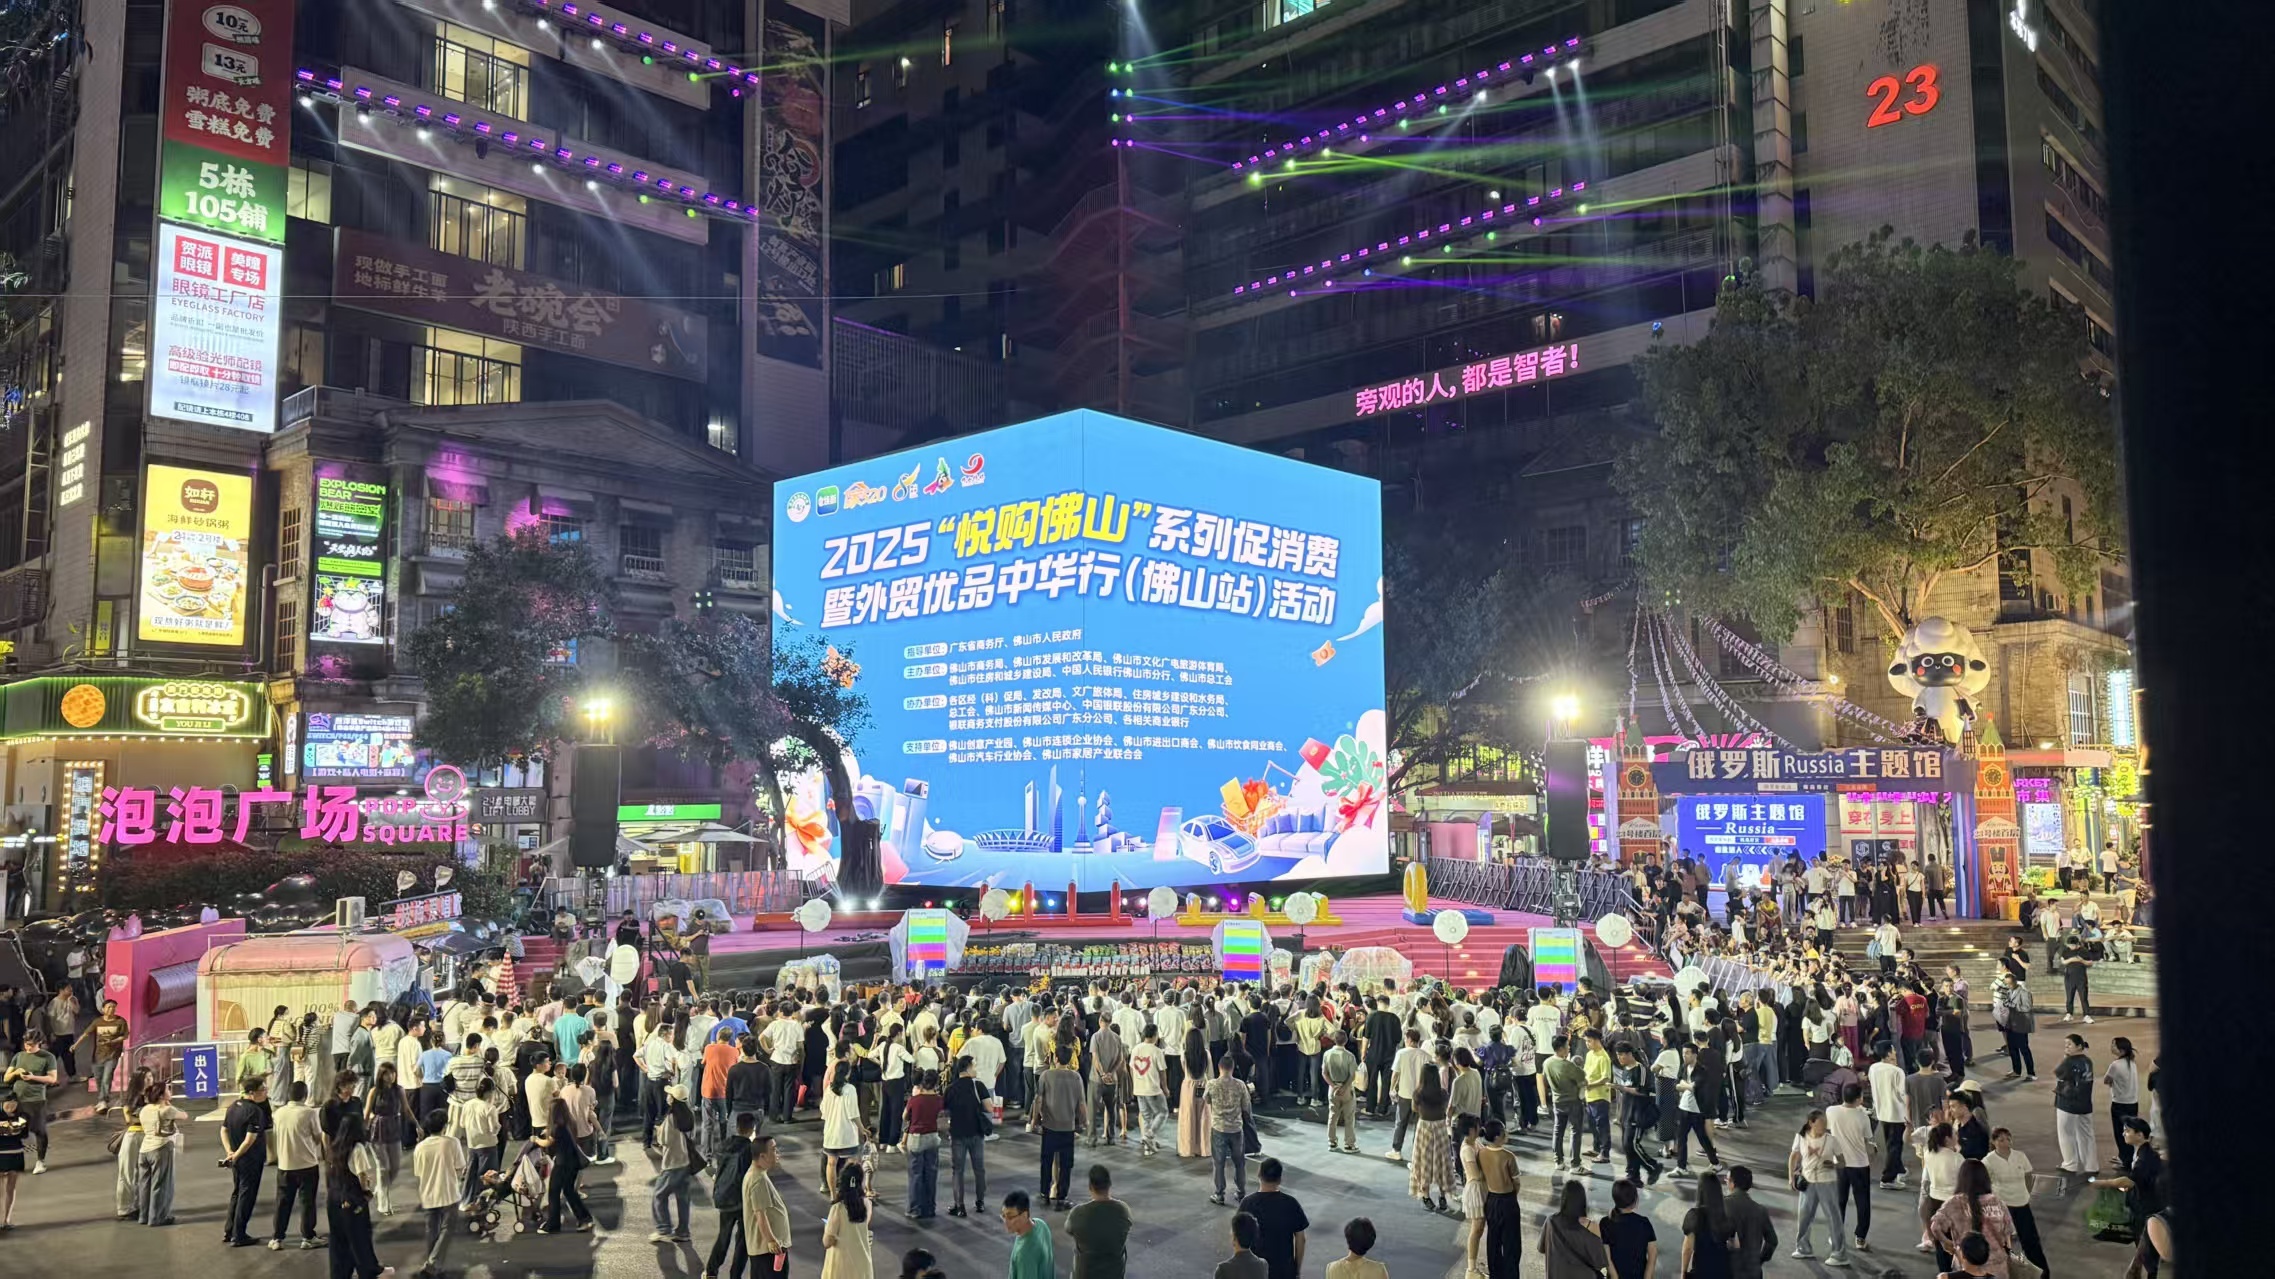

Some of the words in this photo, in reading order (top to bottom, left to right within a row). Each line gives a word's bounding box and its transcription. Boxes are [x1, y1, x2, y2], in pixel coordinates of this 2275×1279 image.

[215, 12, 249, 32] 10元
[214, 54, 247, 73] 13元
[186, 86, 276, 125] 粥底免费
[1867, 65, 1940, 128] 23
[185, 109, 275, 149] 雪糕免费
[199, 162, 256, 198] 5栋
[185, 191, 269, 232] 105铺
[182, 241, 213, 260] 贺派
[231, 252, 261, 270] 美瞳
[180, 256, 213, 276] 眼镜
[231, 268, 260, 285] 专场
[355, 255, 448, 288] 现做手工面
[172, 278, 265, 311] 眼镜工厂店
[470, 268, 615, 336] 老碗会
[171, 297, 220, 314] EYEGLASS
[222, 307, 265, 322] FACTORY
[503, 319, 586, 349] 陕西手工面
[168, 345, 262, 371] 高级验光师配镜
[1356, 344, 1579, 416] 旁观的人，都是智者！
[184, 485, 216, 501] 如轩
[319, 478, 386, 495] EXPLOSION
[319, 488, 351, 499] BEAR
[167, 514, 229, 529] 海鲜砂锅粥
[820, 551, 1337, 627] 暨外贸优品中华行（佛山站）活动
[949, 628, 1082, 653] 广东省商务厅、佛山市人民政府
[949, 664, 1233, 686] 佛山市住房和城乡建设局、中国人民银行佛山市分行、佛山市总工会
[949, 713, 1190, 730] 银联商务支付股份有限公司广东分公司、各相关商业银行
[949, 748, 1143, 763] 佛山市汽车行业协会、佛山市家居产业联合会
[1688, 750, 1780, 779] 俄罗斯
[1784, 755, 1844, 773] Russia
[1850, 749, 1941, 778] 主题馆
[98, 784, 359, 844] 泡泡广场
[365, 797, 417, 816] POP
[483, 806, 504, 817] LIFT
[506, 806, 536, 816] LOBBY
[1695, 803, 1805, 821] 俄罗斯主题馆
[363, 824, 470, 846] SQUARE
[1724, 822, 1775, 834] Russia
[303, 1002, 340, 1014] 100%
[194, 1054, 208, 1093] 出入口
